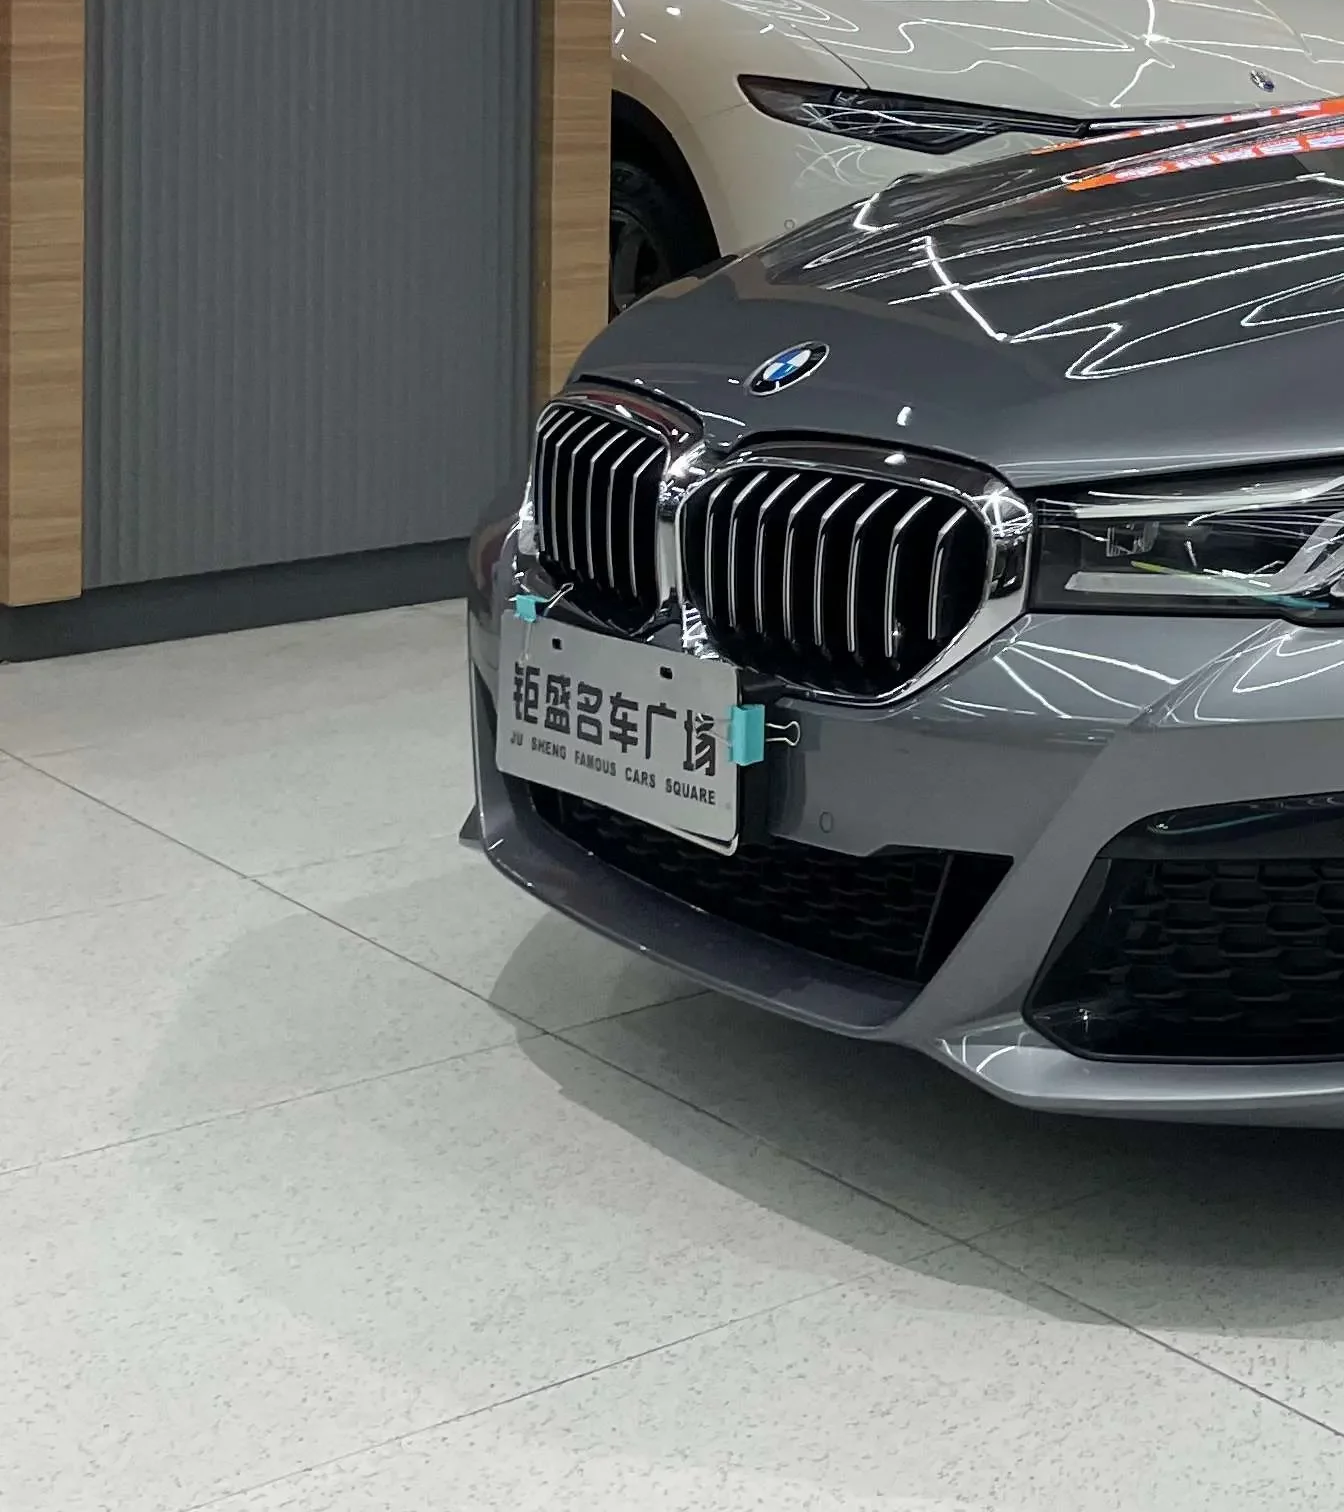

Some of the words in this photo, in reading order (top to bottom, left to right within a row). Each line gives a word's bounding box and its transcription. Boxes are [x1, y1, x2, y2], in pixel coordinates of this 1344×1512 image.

[513, 661, 716, 778] 钜盛名车广场
[510, 731, 524, 747] JU
[531, 737, 567, 761] SHENG
[575, 750, 617, 777] FAMOUS
[625, 767, 656, 789] CARS
[665, 778, 716, 805] SQUARE
